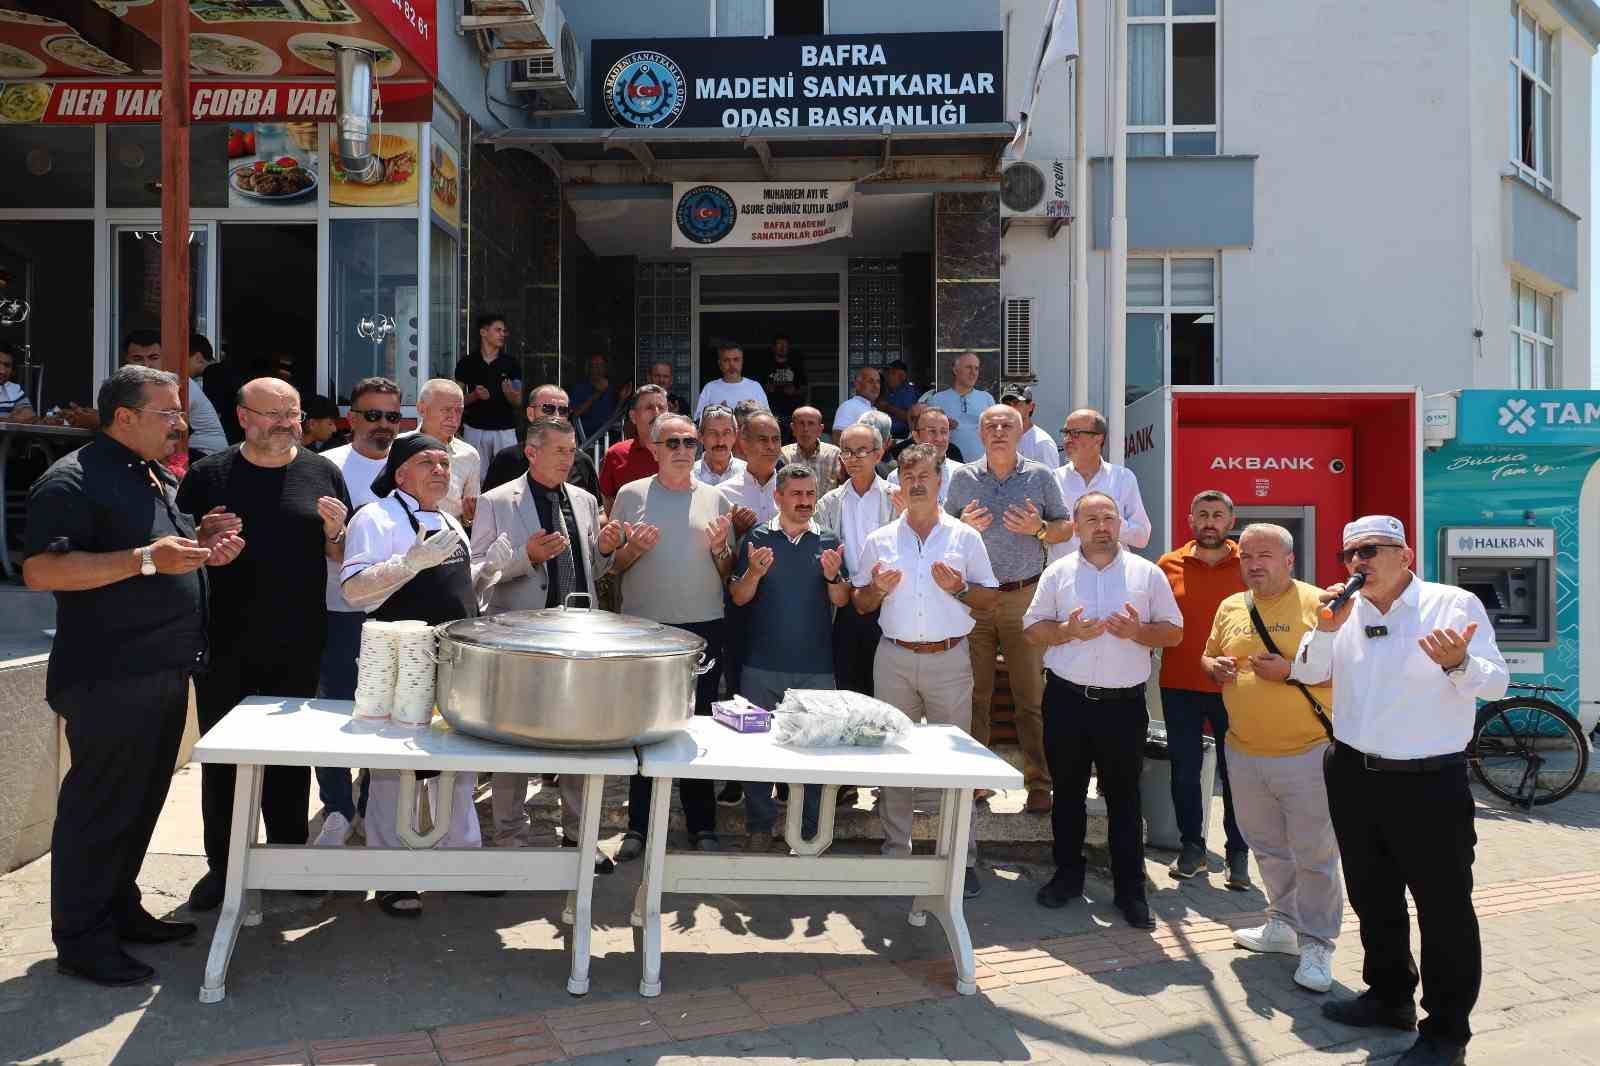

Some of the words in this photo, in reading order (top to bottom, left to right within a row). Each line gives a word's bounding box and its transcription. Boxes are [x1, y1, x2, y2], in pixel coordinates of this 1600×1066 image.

[404, 1, 416, 27] 82
[418, 16, 428, 40] 61
[801, 44, 887, 67] BAFRA
[695, 72, 794, 99] MADENİ
[803, 72, 995, 97] SANATKARLAR
[57, 88, 108, 116] HER
[114, 88, 162, 116] VAK
[191, 88, 278, 120] ÇORBA
[721, 107, 799, 128] ODASI
[1053, 159, 1066, 199] arçelik
[763, 188, 805, 200] MUHARREM
[807, 188, 818, 200] AYI
[820, 188, 829, 199] VE
[767, 202, 800, 214] GÜNÜNÜZ
[803, 204, 824, 214] KUTLU
[763, 221, 791, 229] BAFRA
[793, 218, 826, 228] MADENİ
[752, 231, 811, 240] SANATKARLAR
[1540, 402, 1600, 424] TAM
[1210, 457, 1314, 470] AKBANK
[1475, 537, 1545, 549] HALKBANK
